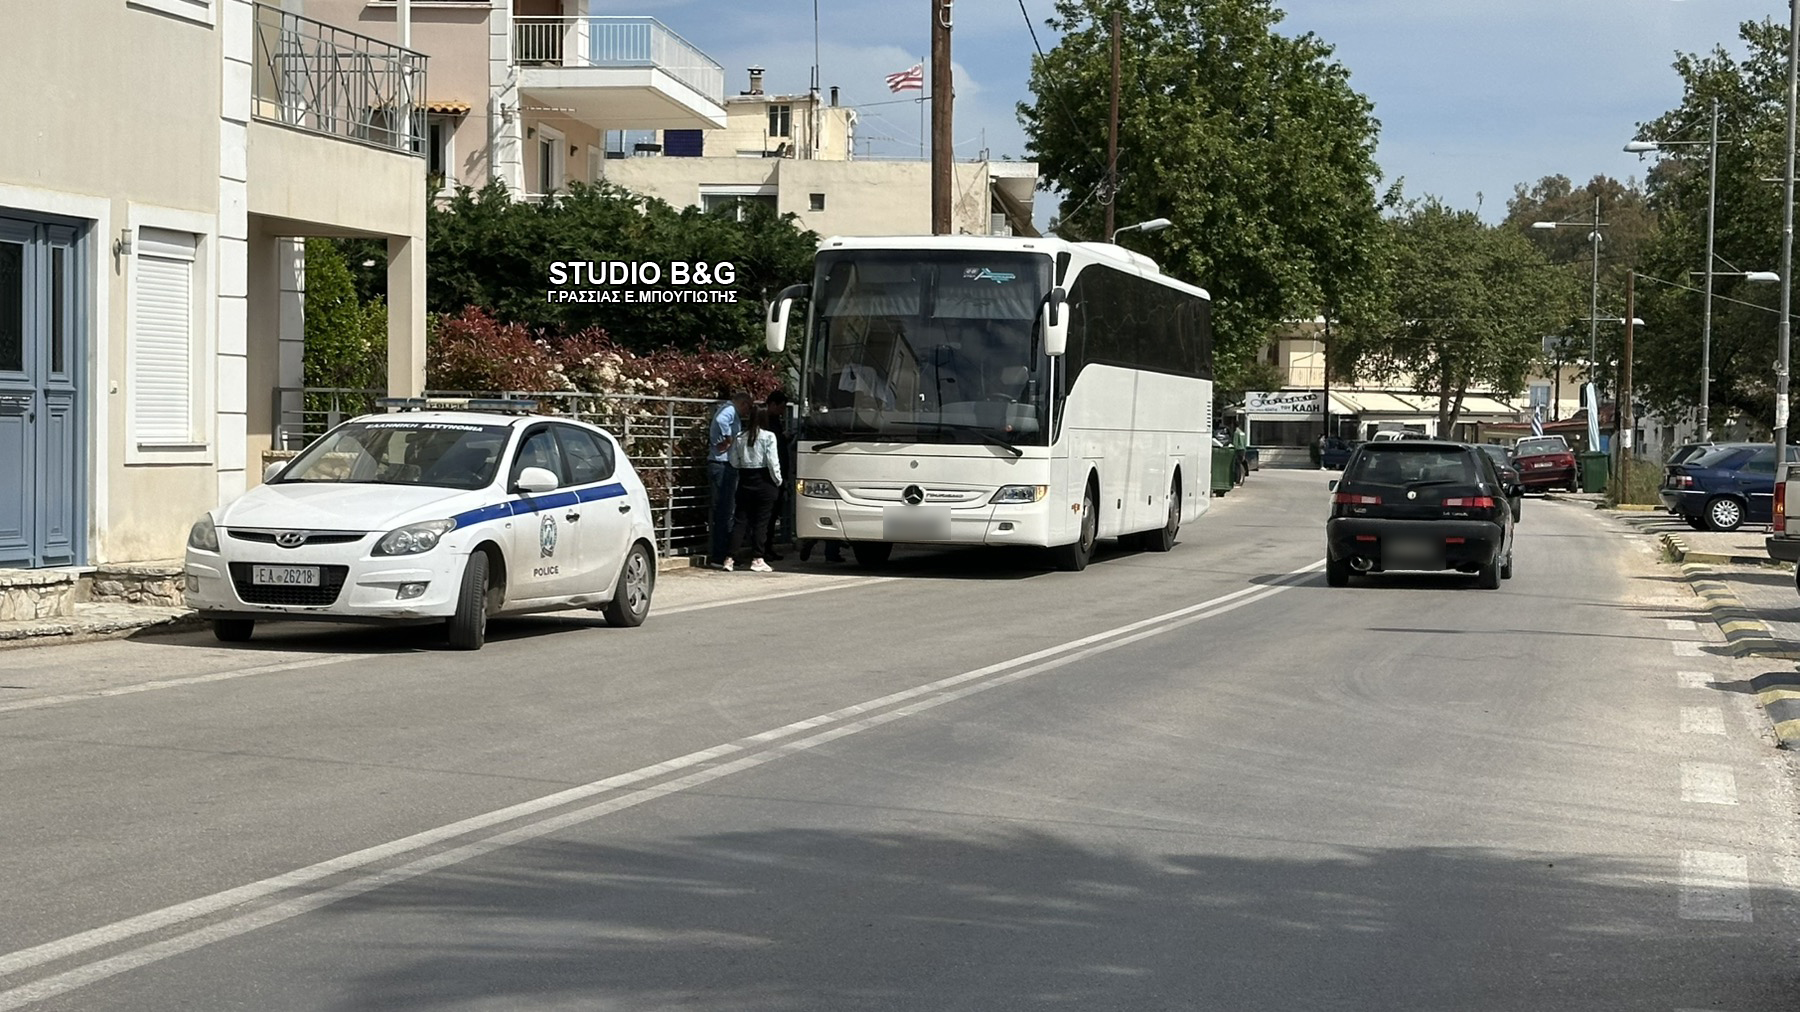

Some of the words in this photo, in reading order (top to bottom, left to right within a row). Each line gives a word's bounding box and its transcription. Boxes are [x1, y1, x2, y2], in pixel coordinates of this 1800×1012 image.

[1292, 404, 1319, 412] ΚΑΔΗ
[422, 424, 483, 432] ΑΣΤΥΝΟΜΙΑ
[533, 565, 559, 577] POLICE
[283, 569, 312, 584] 26218
